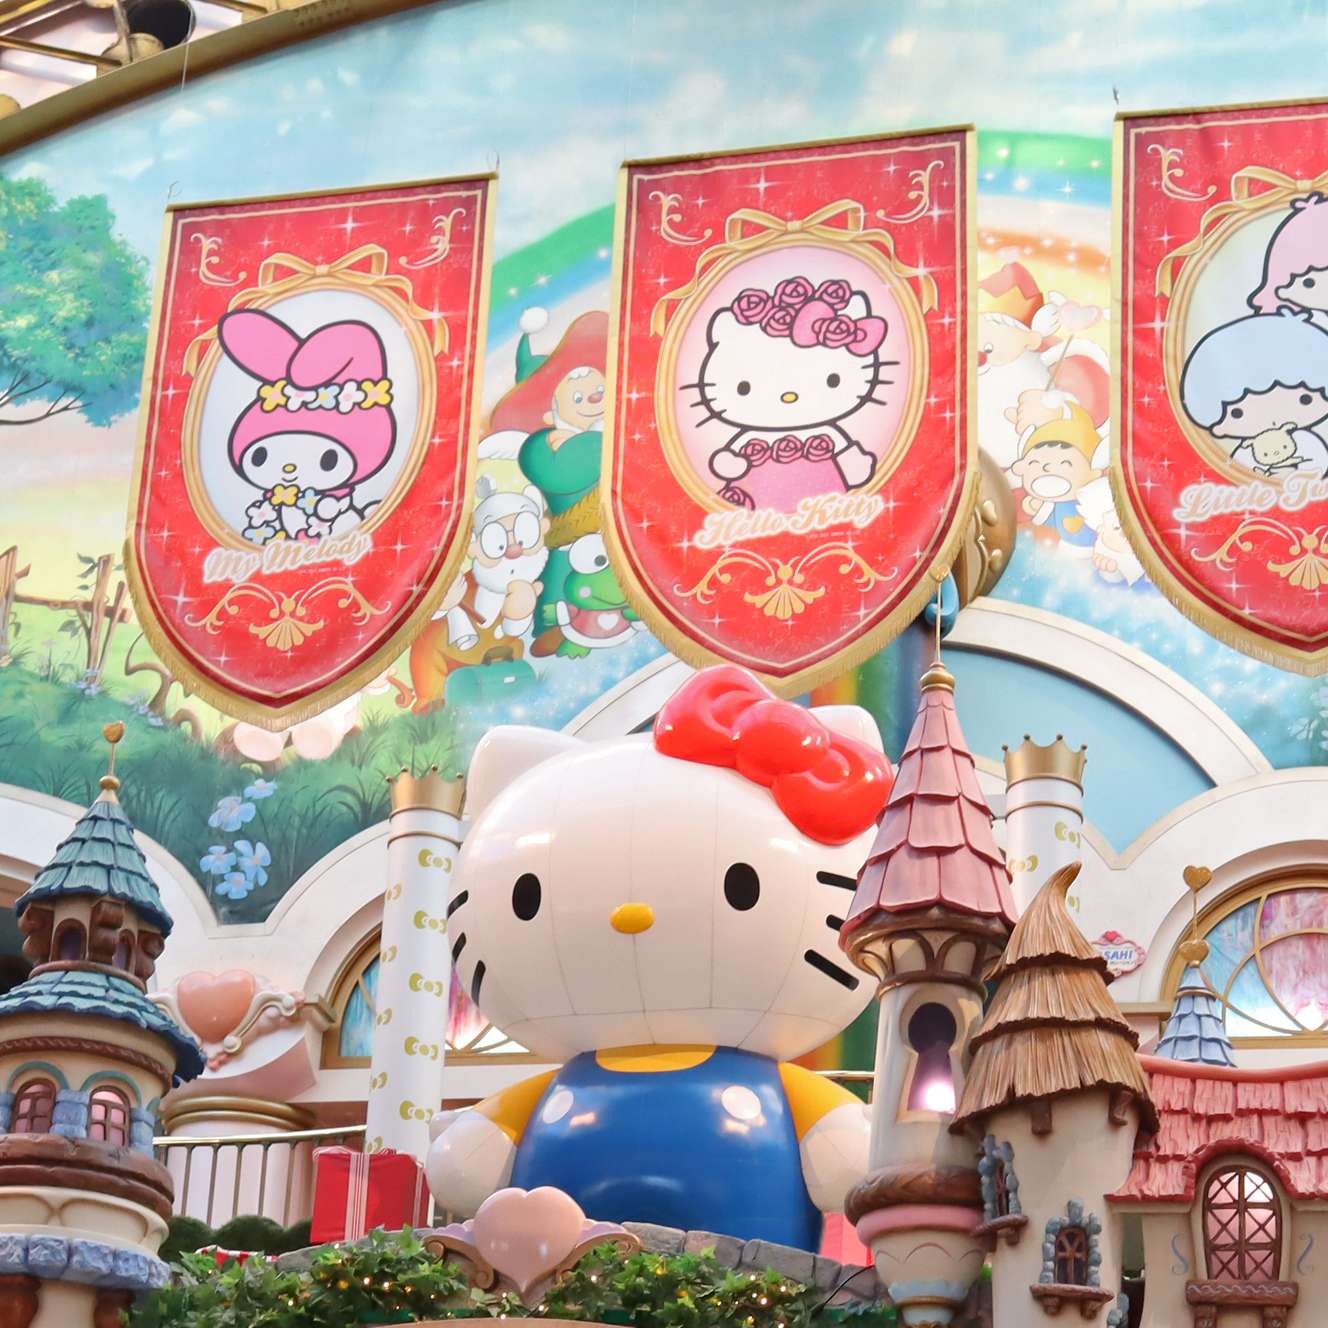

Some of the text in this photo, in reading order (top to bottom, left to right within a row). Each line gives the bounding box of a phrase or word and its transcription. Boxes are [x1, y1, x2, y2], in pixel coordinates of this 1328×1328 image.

[693, 491, 886, 549] Hello Kitty
[1173, 480, 1276, 523] Little
[203, 528, 374, 584] My Melody
[1103, 950, 1134, 961] SAHI
